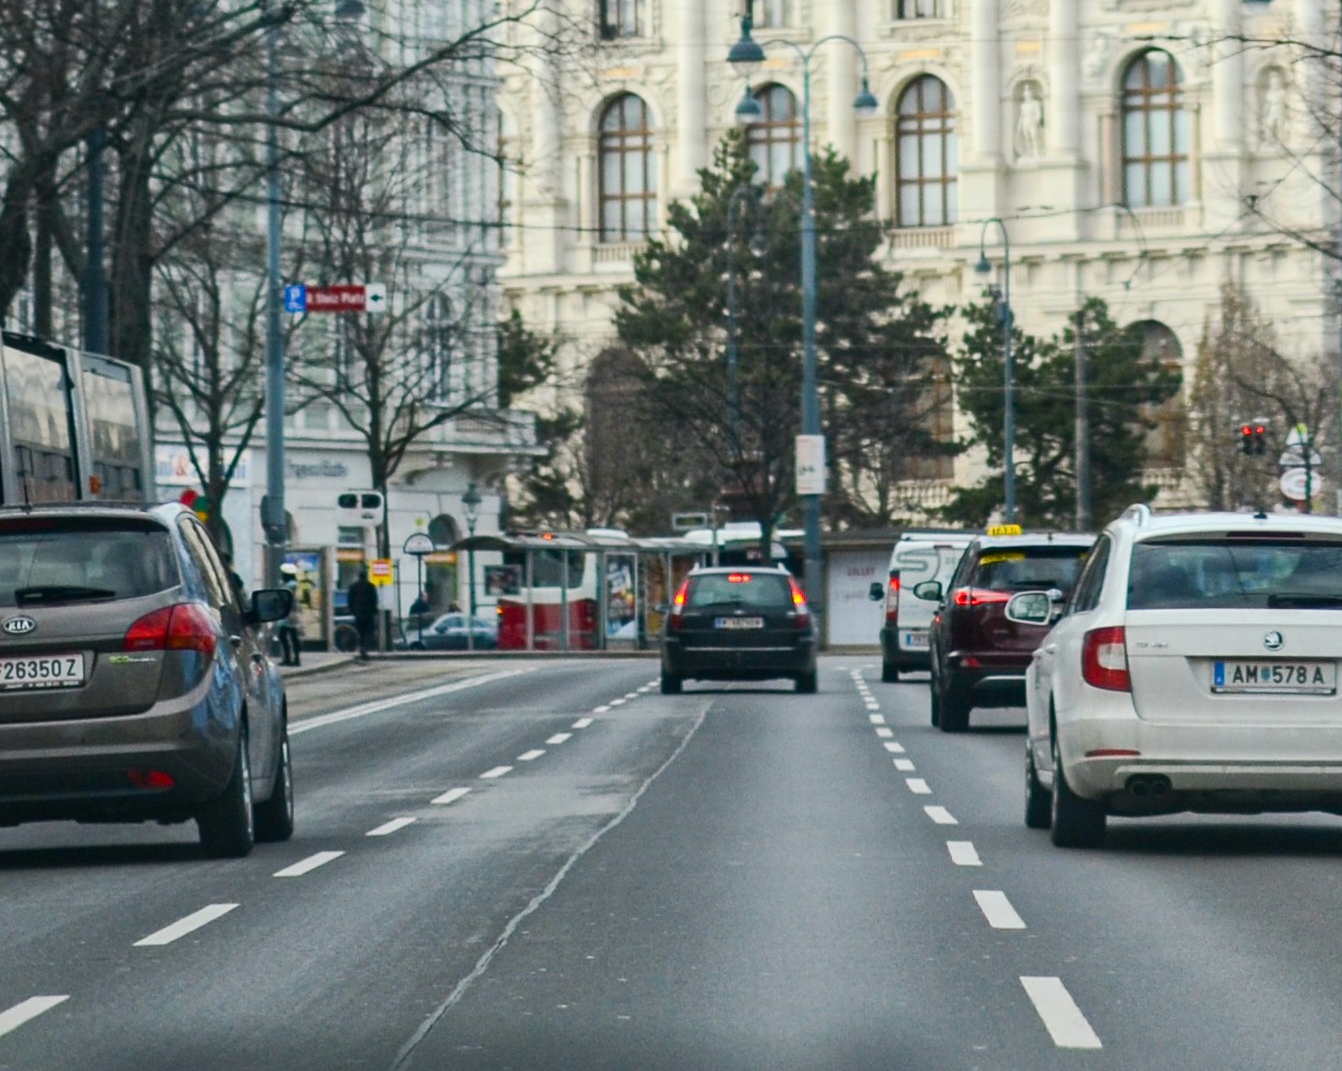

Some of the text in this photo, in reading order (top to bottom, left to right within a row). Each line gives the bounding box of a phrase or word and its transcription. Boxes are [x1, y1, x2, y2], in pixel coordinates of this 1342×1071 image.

[7, 619, 31, 631] KIA
[1232, 665, 1325, 685] AM 578 A
